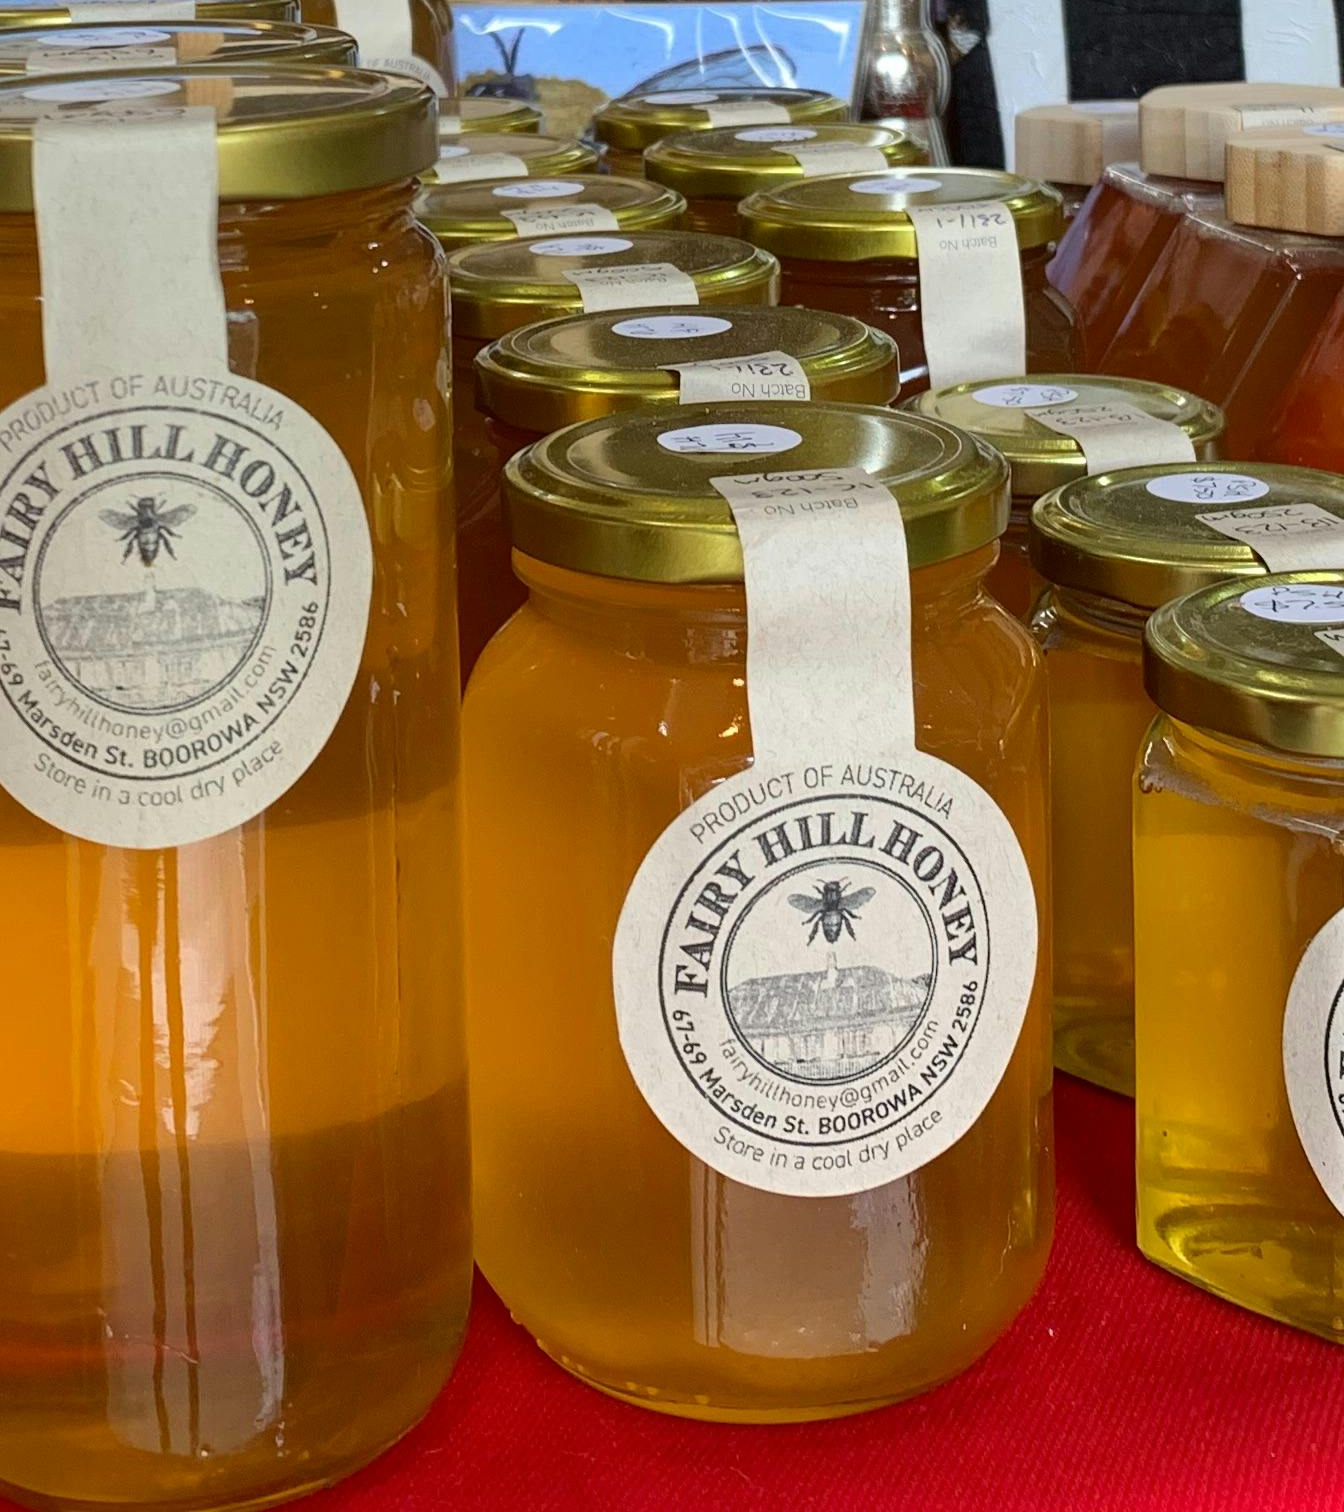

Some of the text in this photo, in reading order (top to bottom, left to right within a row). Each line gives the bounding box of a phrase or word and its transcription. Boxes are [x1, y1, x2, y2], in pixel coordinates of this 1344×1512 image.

[939, 236, 997, 251] Batch No
[109, 374, 143, 399] OF
[154, 376, 286, 432] AUSTRALIA
[731, 383, 806, 399] Batch No
[58, 424, 196, 481] HILL
[205, 433, 319, 588] HONEY
[764, 496, 858, 517] Batch No
[17, 689, 97, 762] Marsden
[103, 744, 134, 770] St.
[142, 712, 261, 771] BOOROWA
[257, 665, 300, 715] NSW
[290, 601, 320, 658] 2586
[34, 643, 278, 744] fairyhillhoney@gmail.com
[33, 737, 285, 808] Store in a cool dry place
[690, 764, 955, 845] PRODUCT OF AUSTRALIA
[673, 812, 979, 998] FAIRY HILL HONEY
[673, 980, 979, 1136] 67-69 Marsden St. BOOROWA NSW 2586
[718, 1018, 939, 1112] fairyhillhoney@gmail.com
[713, 1107, 944, 1172] Store in a cool dry place
